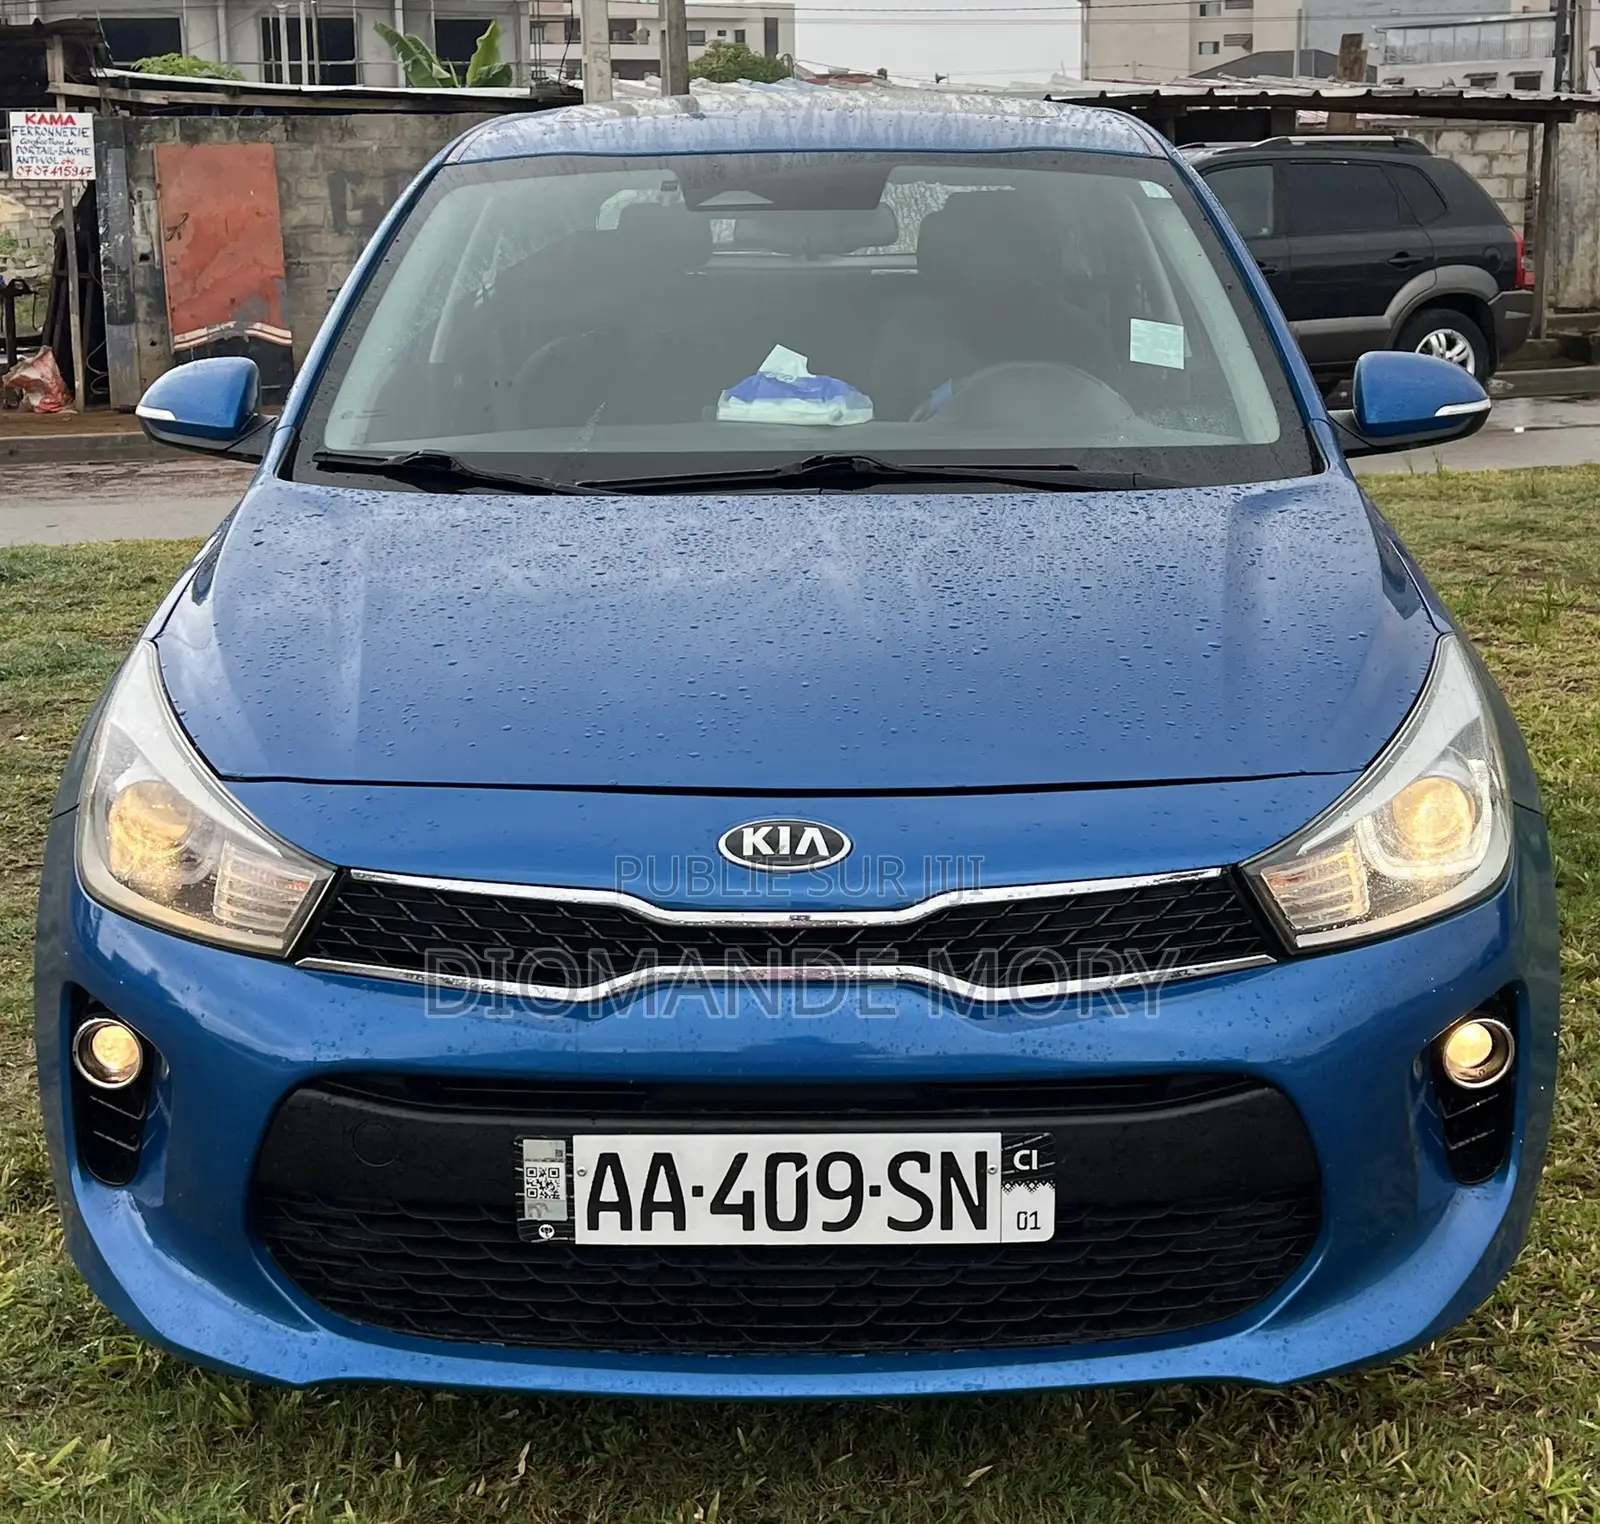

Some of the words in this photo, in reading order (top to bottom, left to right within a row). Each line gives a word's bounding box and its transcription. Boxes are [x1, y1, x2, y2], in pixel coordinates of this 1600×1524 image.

[24, 113, 76, 126] KAMA
[11, 126, 91, 138] FERRONNERIE
[741, 825, 830, 856] KIA
[1013, 1149, 1038, 1171] CI
[1016, 1210, 1041, 1231] 01
